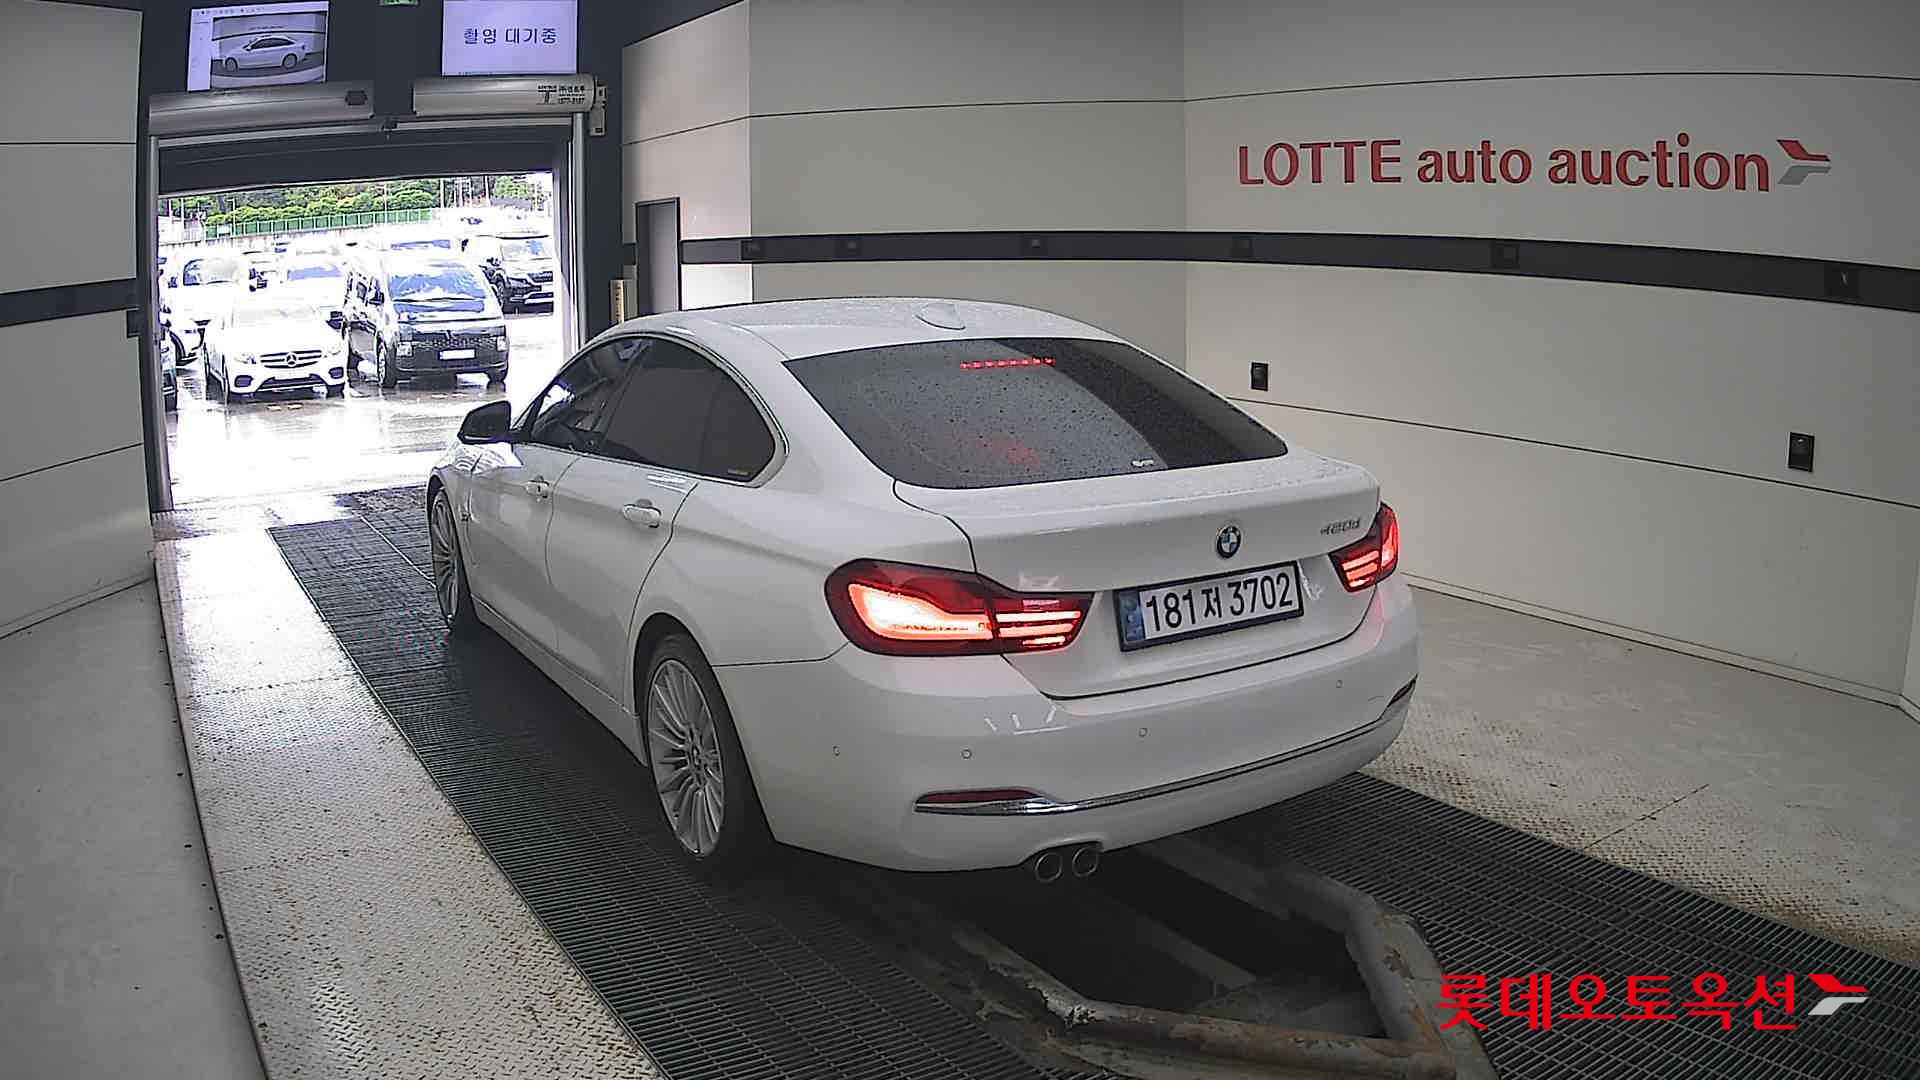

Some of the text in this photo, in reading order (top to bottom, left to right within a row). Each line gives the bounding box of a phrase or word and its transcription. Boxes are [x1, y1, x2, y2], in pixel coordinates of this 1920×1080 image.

[464, 27, 557, 44] 촬영 대기중
[1239, 132, 1769, 192] LOTTE auto auction
